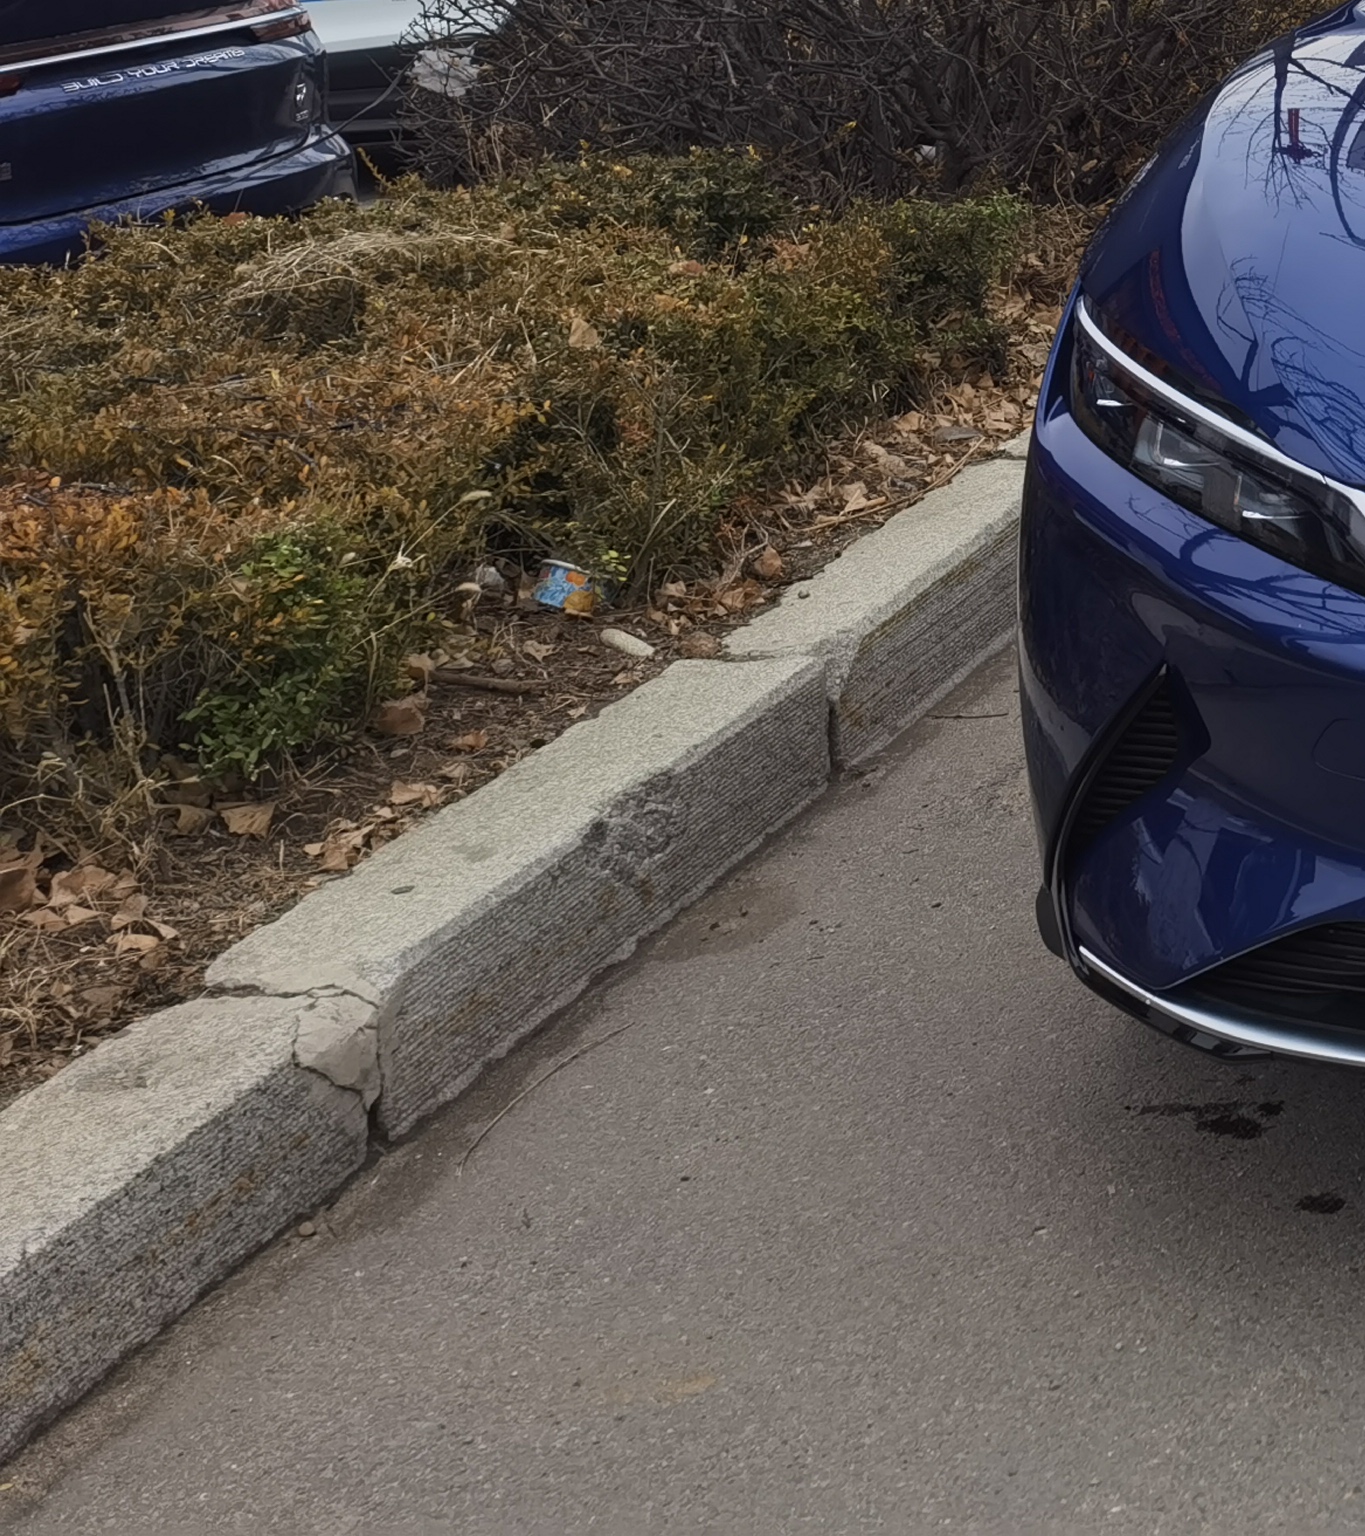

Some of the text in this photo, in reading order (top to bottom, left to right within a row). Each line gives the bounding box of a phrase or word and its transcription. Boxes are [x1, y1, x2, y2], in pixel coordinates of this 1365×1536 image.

[62, 48, 246, 93] BUILD YOUR DREAMS
